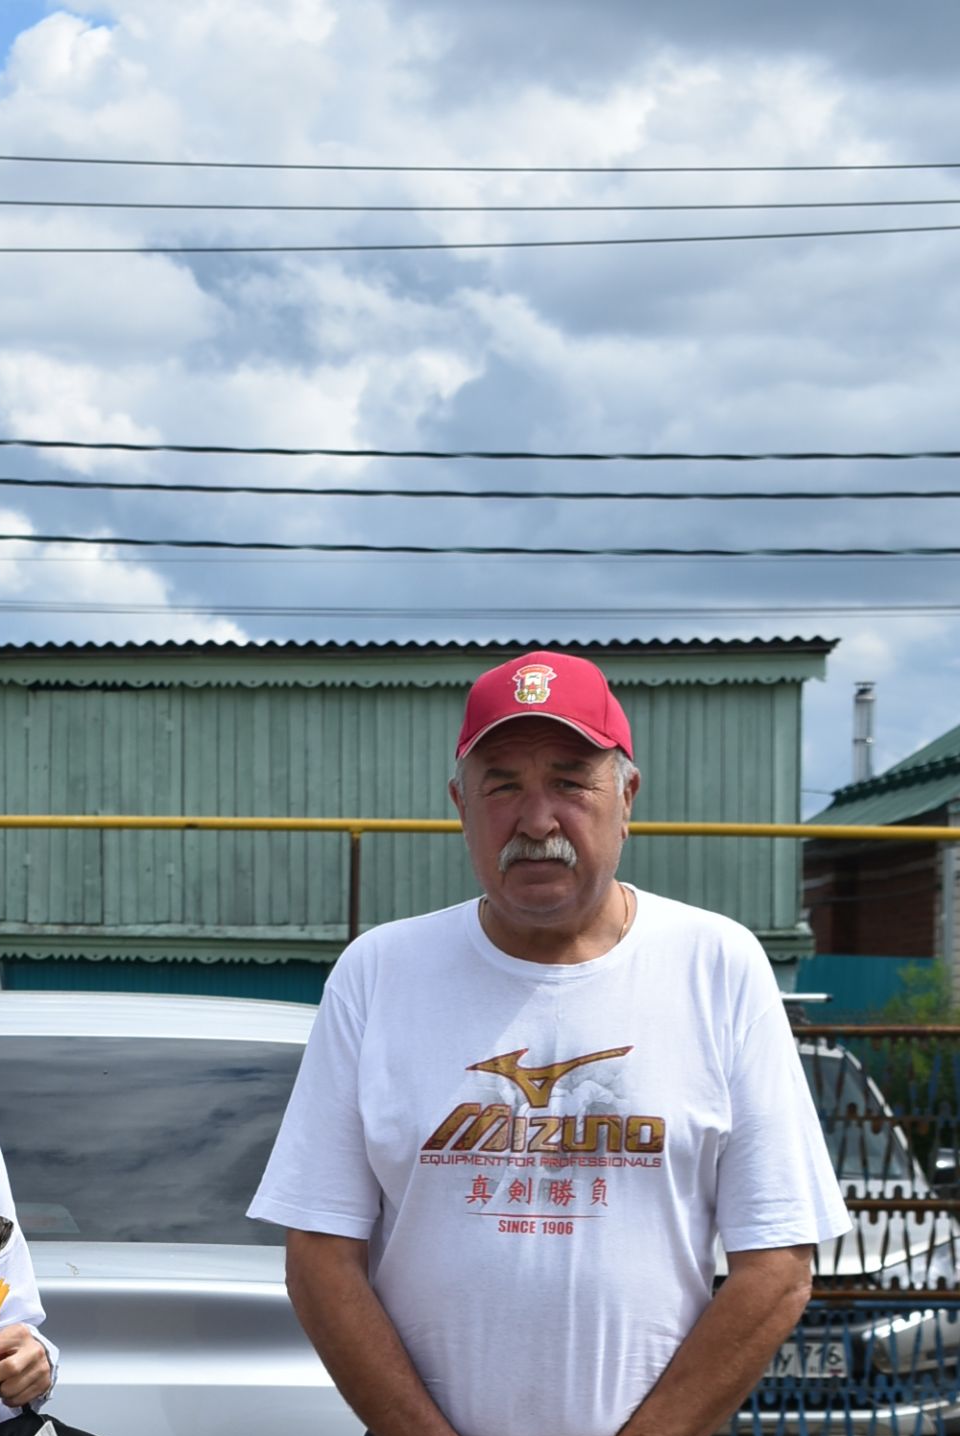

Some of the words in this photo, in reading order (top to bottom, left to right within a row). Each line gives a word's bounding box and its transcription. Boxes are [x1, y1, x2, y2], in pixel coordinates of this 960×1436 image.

[420, 1154, 503, 1167] EQUIPMENT
[507, 1155, 536, 1168] FOR
[540, 1156, 662, 1168] PROFESSIONALS
[464, 1173, 609, 1207] 真剣勝負
[498, 1219, 536, 1234] SINCE
[541, 1220, 574, 1235] 1906
